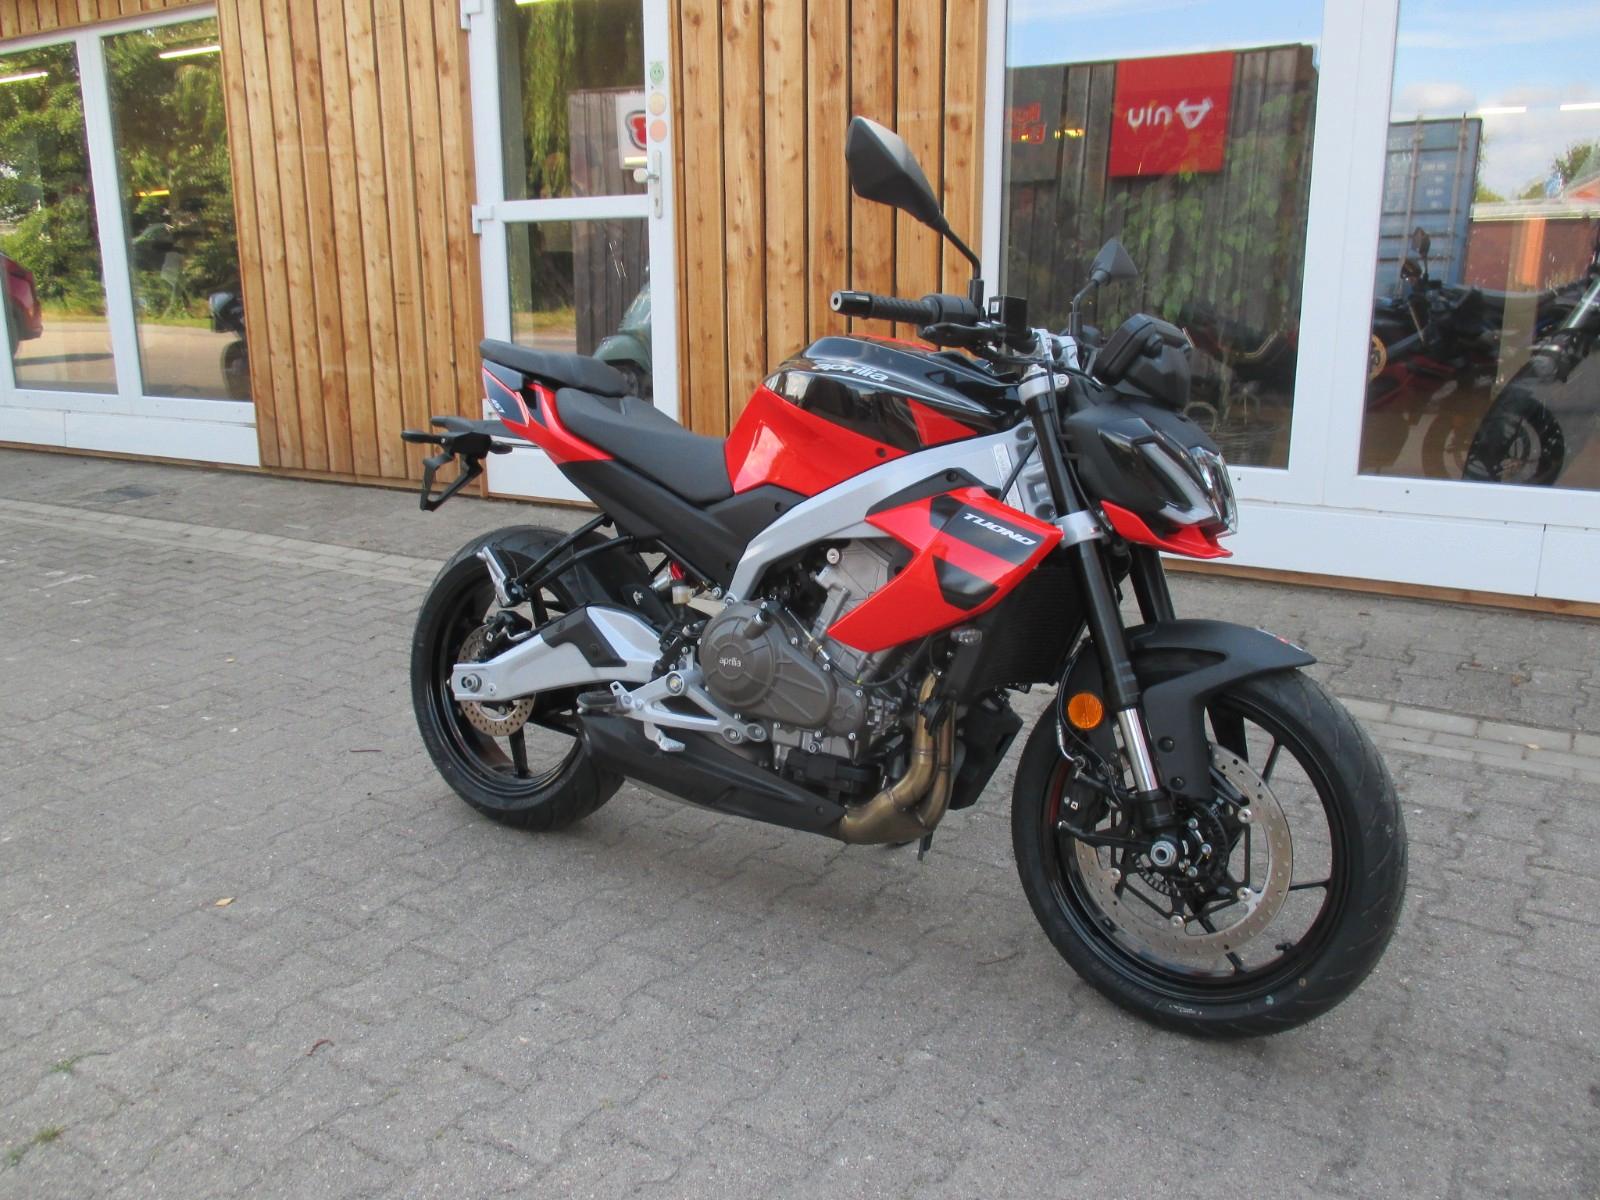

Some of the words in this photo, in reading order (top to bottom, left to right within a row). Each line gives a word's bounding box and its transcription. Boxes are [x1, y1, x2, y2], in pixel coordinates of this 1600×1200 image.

[812, 360, 889, 382] aprilia
[963, 512, 1037, 546] TUONO
[719, 657, 742, 667] aprilia
